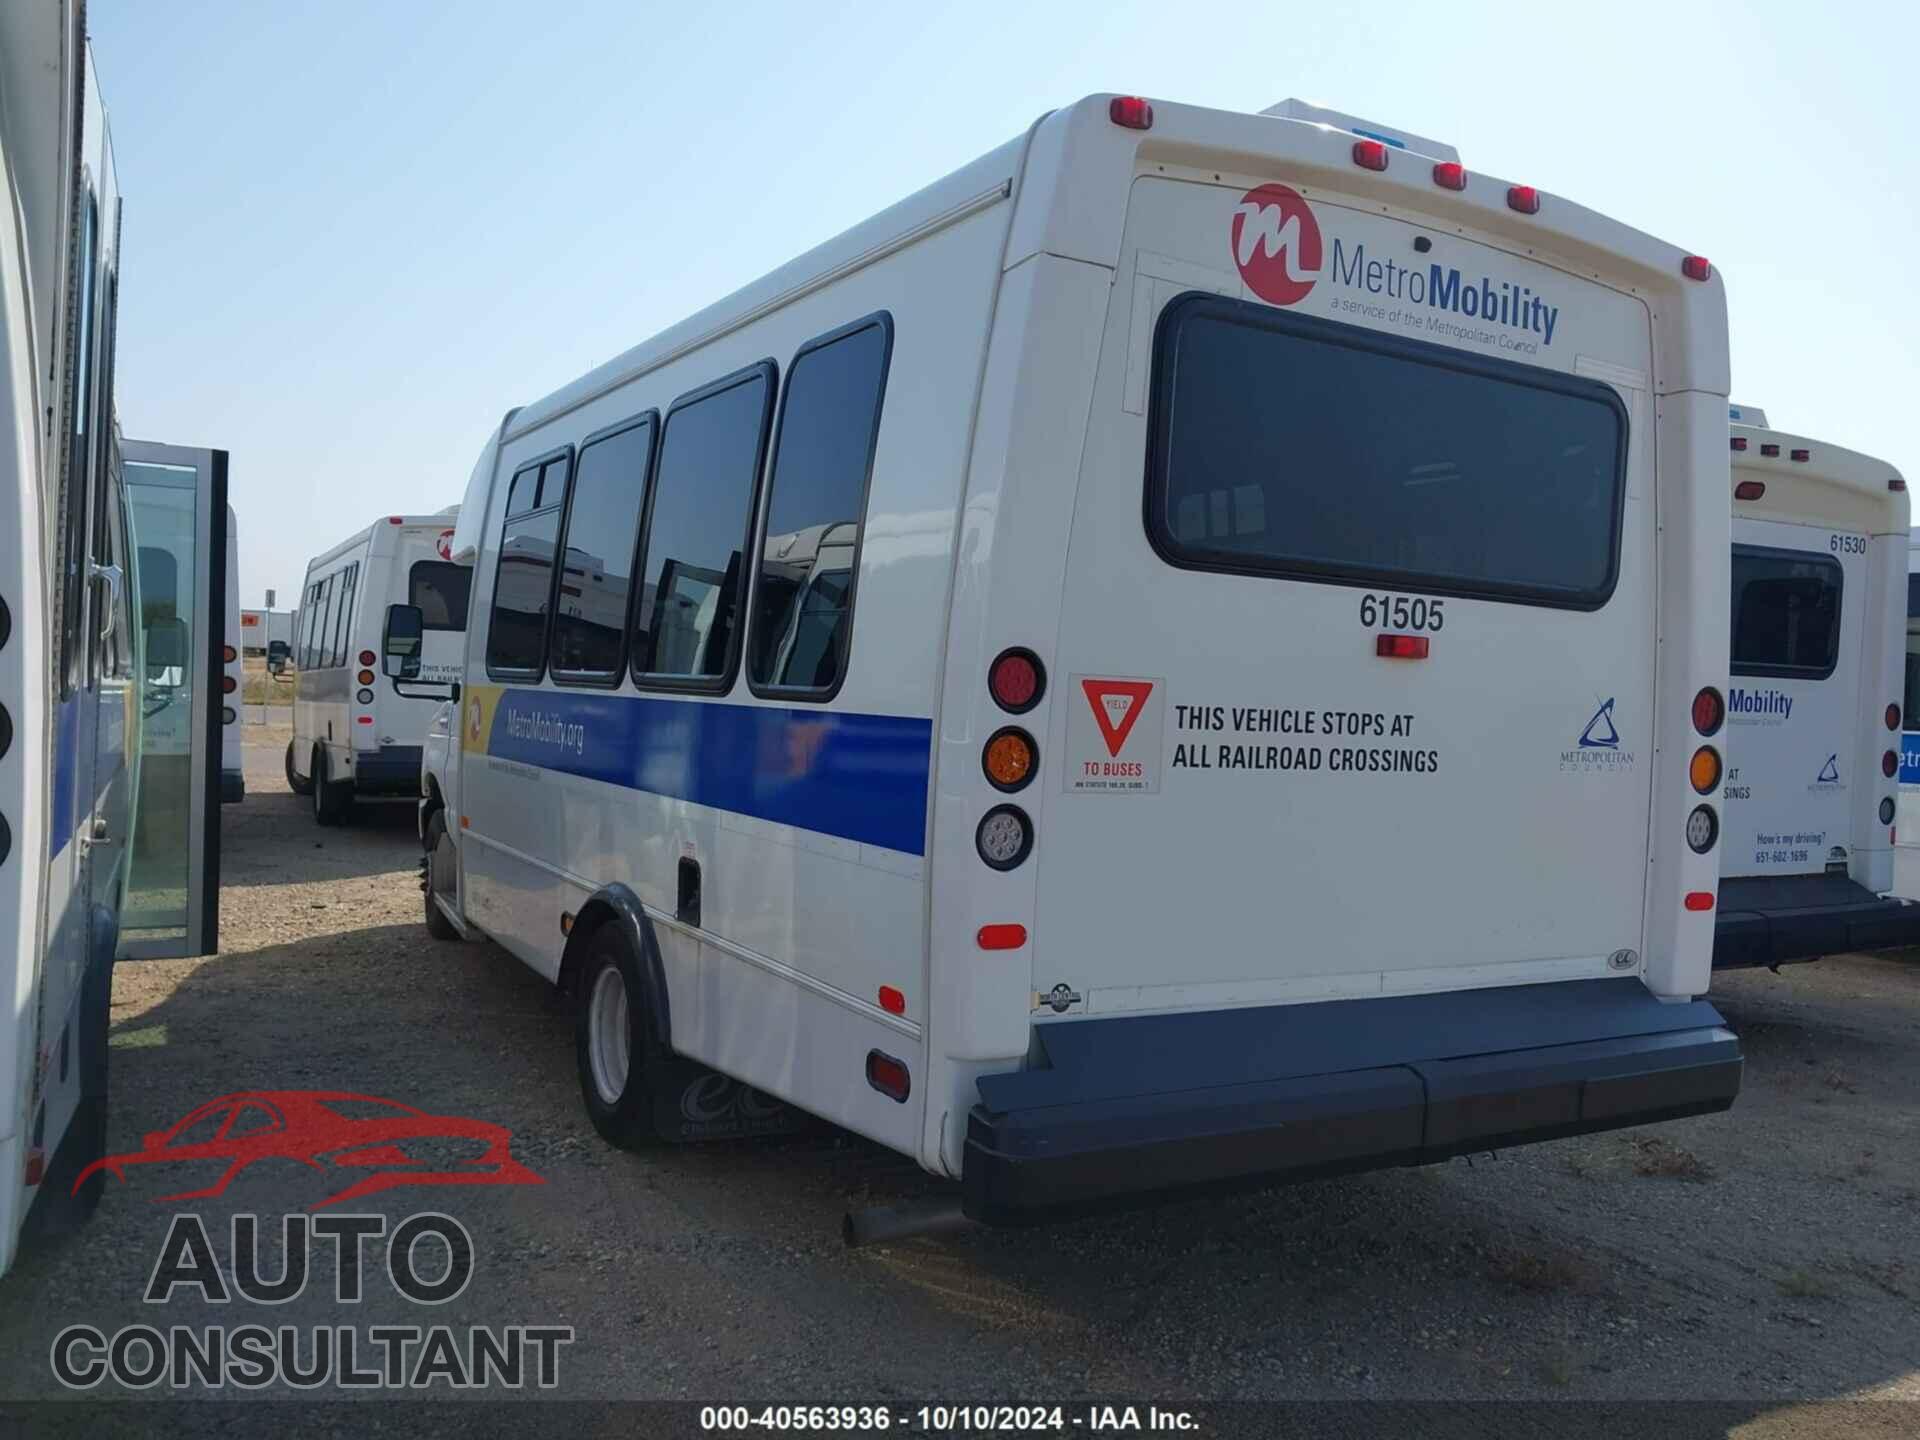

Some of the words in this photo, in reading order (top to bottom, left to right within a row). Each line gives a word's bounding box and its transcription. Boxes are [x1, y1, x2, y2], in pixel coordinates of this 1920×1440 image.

[1331, 237, 1559, 346] MetroMobility
[1331, 298, 1339, 309] a
[1342, 300, 1386, 320] service
[1388, 307, 1402, 323] of
[1404, 311, 1424, 328] the
[1425, 316, 1497, 347] Metropolitan
[1499, 333, 1539, 354] Council
[1830, 534, 1867, 554] 61530
[1359, 594, 1444, 632] 61505
[1728, 688, 1794, 720] Mobility
[506, 707, 585, 756] MetroMobility.org
[1175, 705, 1225, 731] THIS
[1231, 707, 1317, 734] VEHICLE
[1322, 711, 1385, 736] STOPS
[1390, 714, 1415, 737] AT
[1084, 762, 1100, 776] TO
[1103, 763, 1143, 777] BUSES
[1172, 743, 1212, 769] ALL
[1217, 744, 1323, 771] RAILROAD
[1328, 748, 1439, 773] CROSSINGS
[1559, 751, 1635, 764] METROPOLITAN
[1727, 768, 1740, 781] AT
[1782, 835, 1793, 847] my
[1795, 831, 1826, 846] driving?
